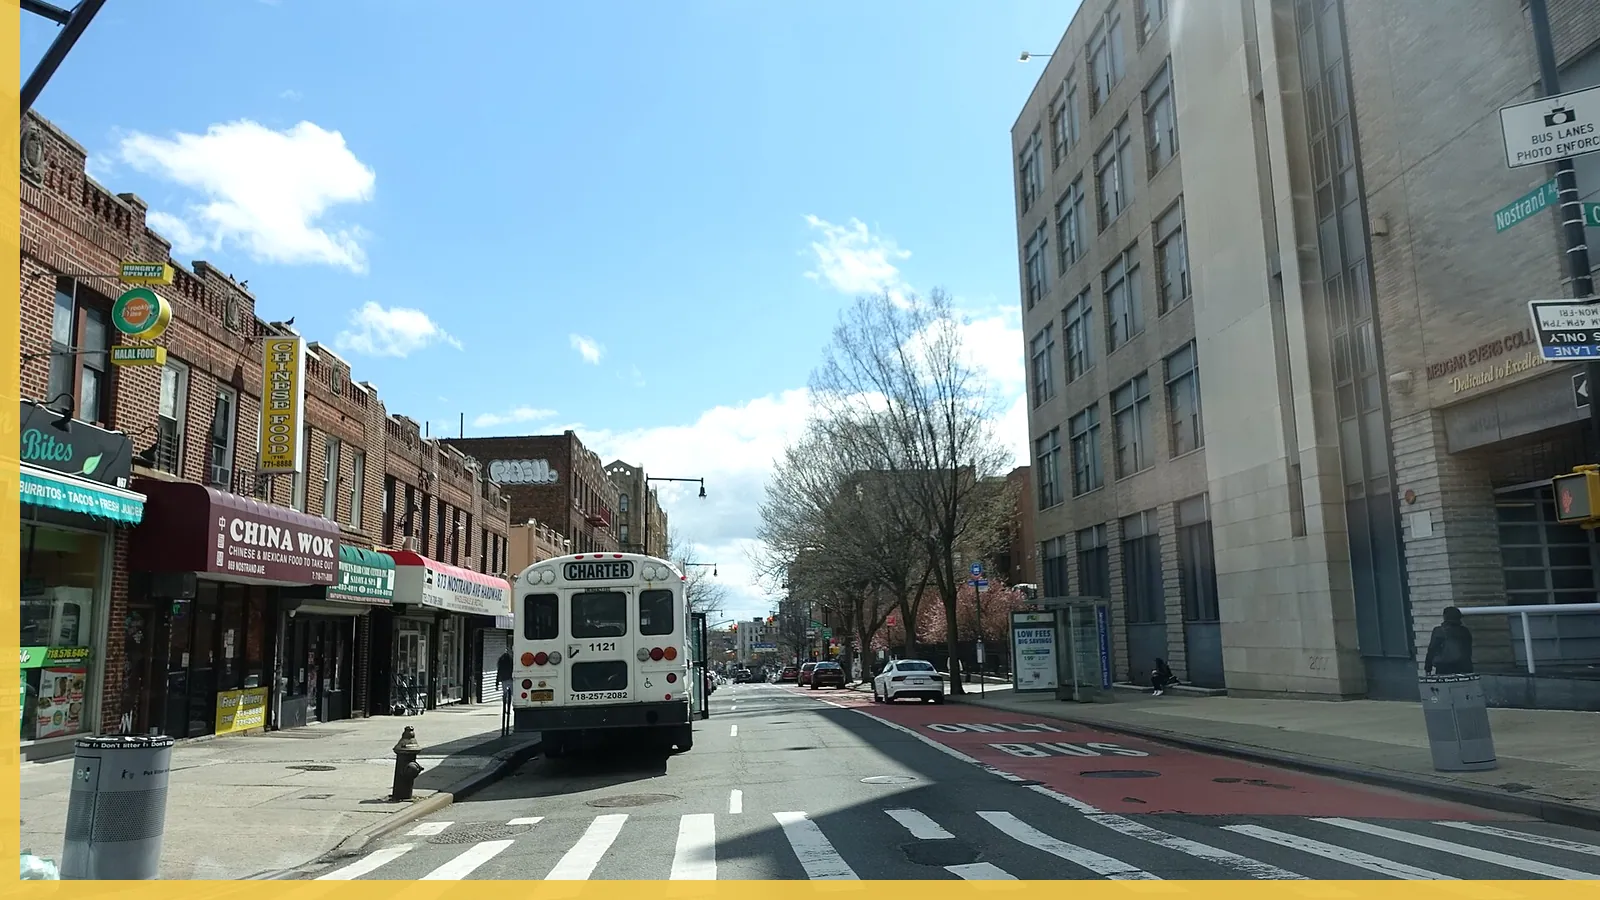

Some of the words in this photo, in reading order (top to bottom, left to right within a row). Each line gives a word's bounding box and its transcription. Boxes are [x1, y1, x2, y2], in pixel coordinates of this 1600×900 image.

[1531, 132, 1553, 145] BUS
[1558, 123, 1594, 140] LANES
[1516, 146, 1552, 161] PHOTO
[1496, 188, 1546, 230] Nostrand
[1559, 308, 1599, 317] MON-FRI
[1542, 319, 1586, 328] 4PM-7PM
[1550, 332, 1587, 342] ONLY
[114, 348, 136, 359] HALAL
[137, 349, 155, 359] FOOD
[1468, 340, 1503, 366] EVERS
[1503, 328, 1538, 351] COLL
[1553, 346, 1591, 356] LANE
[270, 341, 293, 410] CHINESE
[1495, 365, 1505, 378] to
[268, 413, 291, 455] FOOD
[21, 428, 73, 461] Bites
[19, 480, 62, 500] BURRITOS
[67, 490, 94, 506] TACOS
[100, 497, 120, 512] FRESH
[229, 518, 294, 551] CHINA
[297, 532, 334, 558] WOK
[228, 545, 256, 560] CHINESE
[256, 551, 261, 560] &
[262, 551, 287, 564] MEXICAN
[288, 554, 303, 566] FOOD
[303, 557, 310, 567] TO
[311, 558, 323, 570] TAKE
[324, 561, 334, 570] OUT
[235, 561, 257, 574] NOSTRAND
[569, 563, 629, 579] CHARTER
[448, 575, 472, 595] NOSTRAND
[472, 581, 481, 597] AVE
[481, 585, 503, 602] HARDWARE
[1017, 630, 1034, 638] LOW
[1029, 637, 1053, 645] SAVINGS
[589, 642, 616, 651] 1121
[570, 691, 628, 700] 718-257-2082
[927, 722, 1062, 734] ONLY
[988, 742, 1150, 758] BUS
